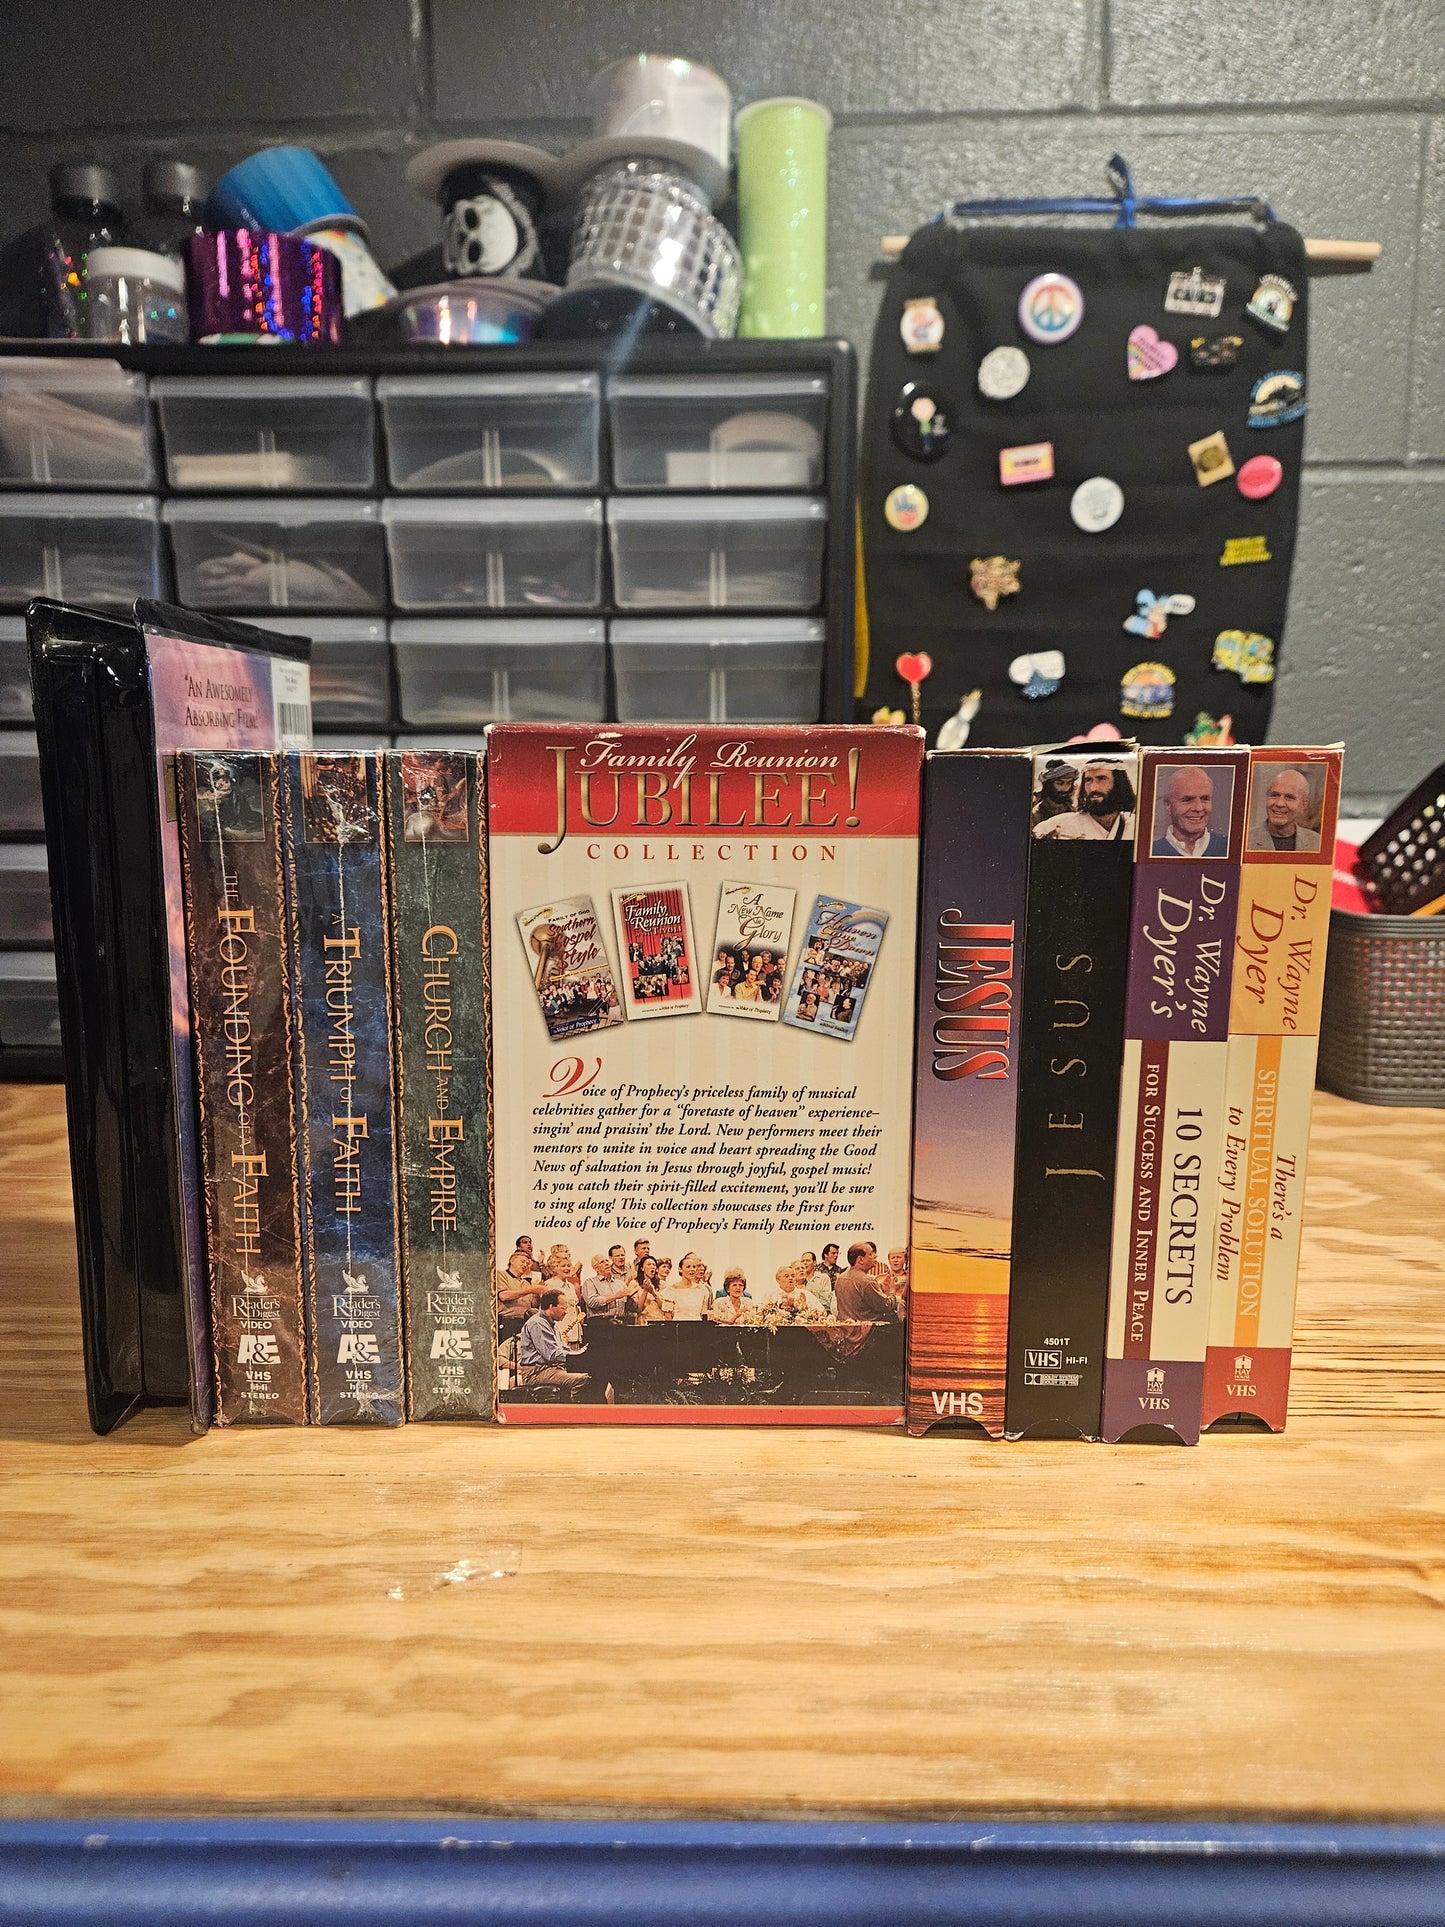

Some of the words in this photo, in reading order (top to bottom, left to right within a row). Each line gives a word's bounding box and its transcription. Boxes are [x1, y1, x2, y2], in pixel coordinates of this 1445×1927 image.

[185, 705, 235, 728] ABSORBING
[580, 733, 698, 789] Family
[709, 741, 841, 768] Reunion
[537, 746, 861, 855] JUBILEE!
[586, 842, 837, 861] COLLECTION
[225, 871, 239, 902] THE
[1198, 873, 1226, 922] Dr.
[1290, 873, 1318, 921] Dr.
[625, 899, 668, 921] Family
[630, 913, 682, 932] Reunion
[733, 916, 783, 952] Glory
[1236, 899, 1284, 1005] Dyer
[421, 924, 459, 1071] CHURCH
[932, 907, 1015, 1081] JESUS
[1185, 938, 1222, 1034] Wayne
[1277, 938, 1313, 1030] Wayne
[217, 905, 257, 1107] FOUNDING
[323, 927, 362, 1081] TRIUMPH
[1045, 953, 1106, 1181] JESUS
[1145, 1063, 1160, 1097] FOR
[436, 1076, 449, 1110] AND
[610, 1084, 626, 1100] of
[692, 1084, 744, 1101] priceless
[745, 1085, 788, 1102] family
[792, 1085, 808, 1102] of
[808, 1085, 858, 1099] musical
[238, 1112, 250, 1131] OF
[532, 1103, 594, 1116] celebrities
[597, 1103, 638, 1120] gather
[638, 1103, 660, 1120] for
[662, 1107, 671, 1116] a
[677, 1104, 734, 1120] “foretaste
[738, 1104, 754, 1121] of
[754, 1104, 805, 1118] heaven”
[1175, 1107, 1203, 1141] 10
[1228, 1106, 1244, 1126] to
[577, 1122, 602, 1135] and
[655, 1122, 674, 1135] the
[678, 1123, 711, 1136] Lord.
[716, 1123, 744, 1136] New
[746, 1124, 815, 1140] performers
[819, 1126, 848, 1137] meet
[852, 1125, 882, 1137] their
[1140, 1104, 1161, 1179] SUCCESS
[1249, 1069, 1277, 1190] SPIRITUAL
[331, 1113, 370, 1213] FAITH
[533, 1143, 582, 1154] mentors
[587, 1143, 598, 1154] to
[603, 1142, 635, 1154] unite
[639, 1142, 651, 1154] in
[657, 1142, 687, 1155] voice
[691, 1142, 716, 1155] and
[719, 1142, 753, 1155] heart
[756, 1143, 816, 1160] spreading
[820, 1143, 839, 1156] the
[843, 1143, 878, 1156] Good
[1217, 1132, 1247, 1191] Every
[427, 1115, 465, 1233] EMPIRE
[533, 1160, 566, 1172] News
[569, 1160, 585, 1176] of
[585, 1160, 641, 1173] salvation
[646, 1161, 658, 1173] in
[661, 1161, 692, 1176] Jesus
[696, 1161, 744, 1177] through
[746, 1162, 787, 1178] joyful,
[790, 1162, 829, 1179] gospel
[832, 1163, 873, 1175] music!
[532, 1179, 548, 1191] As
[550, 1182, 574, 1194] you
[578, 1179, 610, 1191] catch
[613, 1179, 644, 1192] their
[646, 1180, 717, 1196] spirit-filled
[720, 1181, 789, 1195] excitement,
[831, 1182, 846, 1194] be
[849, 1184, 875, 1194] sure
[231, 1150, 269, 1254] FAITH
[534, 1200, 546, 1210] to
[550, 1198, 575, 1213] sing
[578, 1197, 616, 1213] along!
[620, 1198, 647, 1210] This
[650, 1198, 708, 1211] collection
[712, 1199, 772, 1212] showcases
[775, 1200, 795, 1212] the
[796, 1200, 825, 1216] first
[825, 1200, 854, 1216] four
[1138, 1184, 1152, 1221] AND
[534, 1216, 572, 1228] videos
[576, 1216, 591, 1232] of
[591, 1216, 611, 1228] the
[616, 1217, 646, 1229] Voice
[650, 1217, 665, 1232] of
[732, 1218, 775, 1234] Family
[778, 1219, 830, 1231] Reunion
[834, 1221, 875, 1231] events.
[1165, 1153, 1202, 1305] SECRETS
[1271, 1227, 1284, 1240] a
[1217, 1197, 1242, 1281] Problem
[1134, 1229, 1153, 1283] INNER
[1239, 1196, 1267, 1317] SOLUTION
[252, 1308, 281, 1319] Digest
[353, 1308, 381, 1319] Digest
[434, 1316, 466, 1325] VIDEO
[446, 1305, 474, 1315] Digest
[1131, 1288, 1150, 1342] PEACE
[240, 1320, 273, 1330] VIDEO
[340, 1320, 373, 1329] VIDEO
[237, 1334, 281, 1364] A&E
[336, 1334, 381, 1364] A&E
[429, 1330, 474, 1360] A&E
[1043, 1337, 1071, 1346] 4501T
[438, 1366, 465, 1375] VHS
[1028, 1351, 1060, 1367] VHS
[1065, 1356, 1088, 1364] HI-FI
[1234, 1368, 1251, 1376] HAY
[245, 1370, 272, 1380] VHS
[345, 1370, 372, 1380] VHS
[1147, 1381, 1164, 1389] HAY
[240, 1391, 280, 1400] STEREO
[931, 1391, 984, 1415] VHS
[1138, 1397, 1170, 1410] VHS
[1226, 1384, 1257, 1397] VHS
